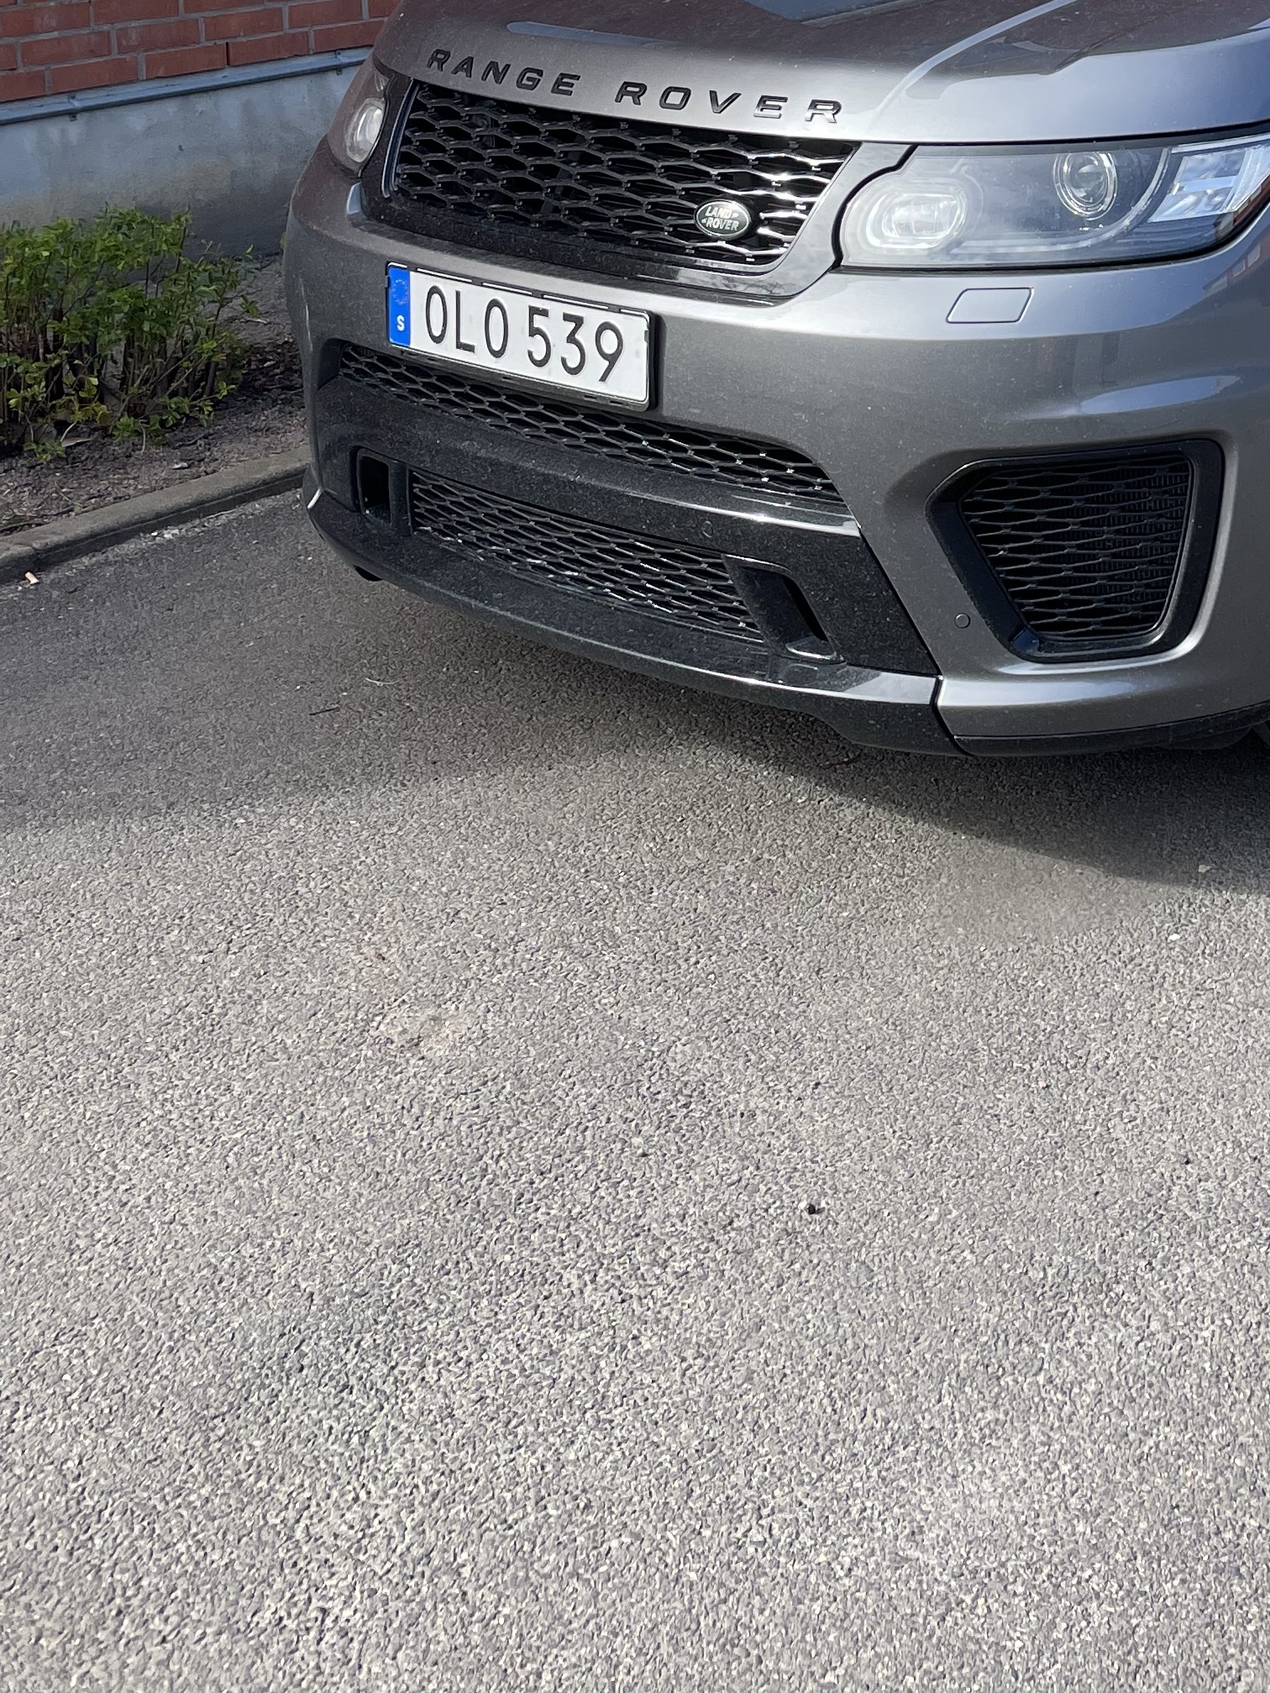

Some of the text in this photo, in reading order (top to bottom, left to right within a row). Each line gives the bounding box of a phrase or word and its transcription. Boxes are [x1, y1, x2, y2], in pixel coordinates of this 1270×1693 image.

[426, 48, 844, 124] RANGE ROVER
[705, 206, 733, 219] LAND
[706, 217, 740, 231] ROVER
[396, 314, 405, 331] S
[425, 285, 624, 383] OLO 539
